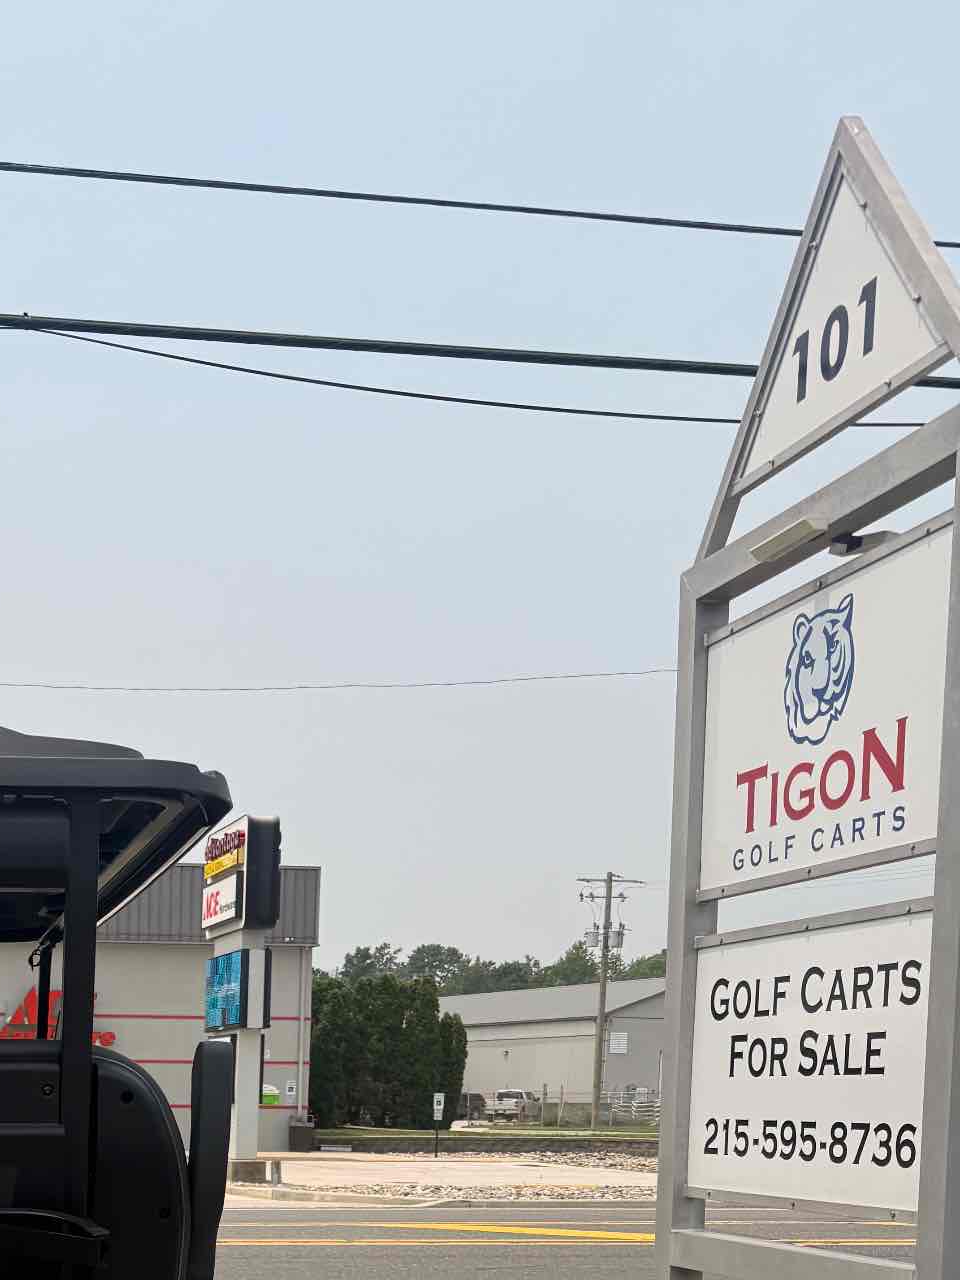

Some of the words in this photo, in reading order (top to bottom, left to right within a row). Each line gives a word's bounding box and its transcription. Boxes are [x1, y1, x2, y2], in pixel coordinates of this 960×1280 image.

[791, 276, 878, 404] 101
[736, 715, 908, 834] TIGON
[732, 835, 796, 871] GOLF
[811, 806, 906, 852] CARTS
[709, 975, 791, 1021] GOLF
[800, 959, 922, 1014] CARTS
[728, 1033, 788, 1077] FOR
[797, 1029, 887, 1077] SALE
[703, 1117, 918, 1169] 215-595-8736
